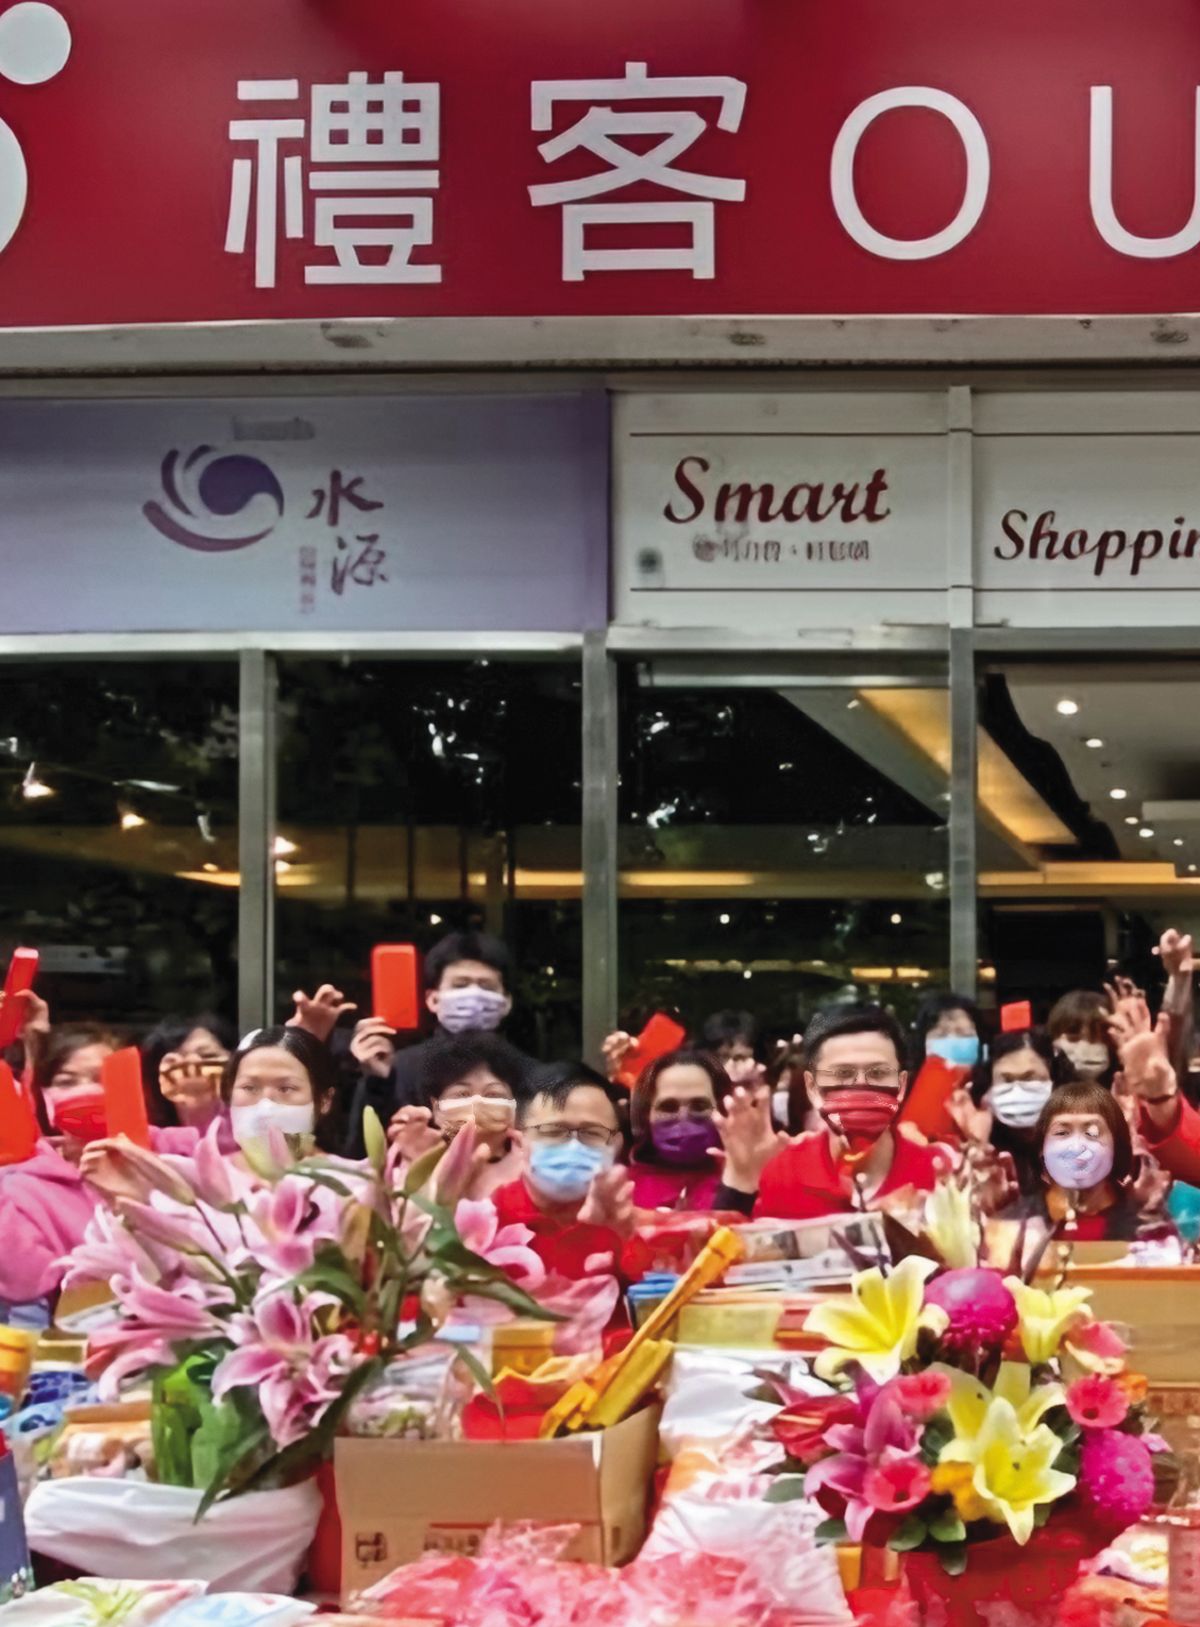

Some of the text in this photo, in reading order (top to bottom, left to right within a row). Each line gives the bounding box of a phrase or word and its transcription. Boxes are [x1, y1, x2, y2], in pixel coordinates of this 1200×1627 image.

[225, 61, 747, 288] 禮客
[305, 470, 388, 596] 水源
[663, 456, 891, 524] Smart
